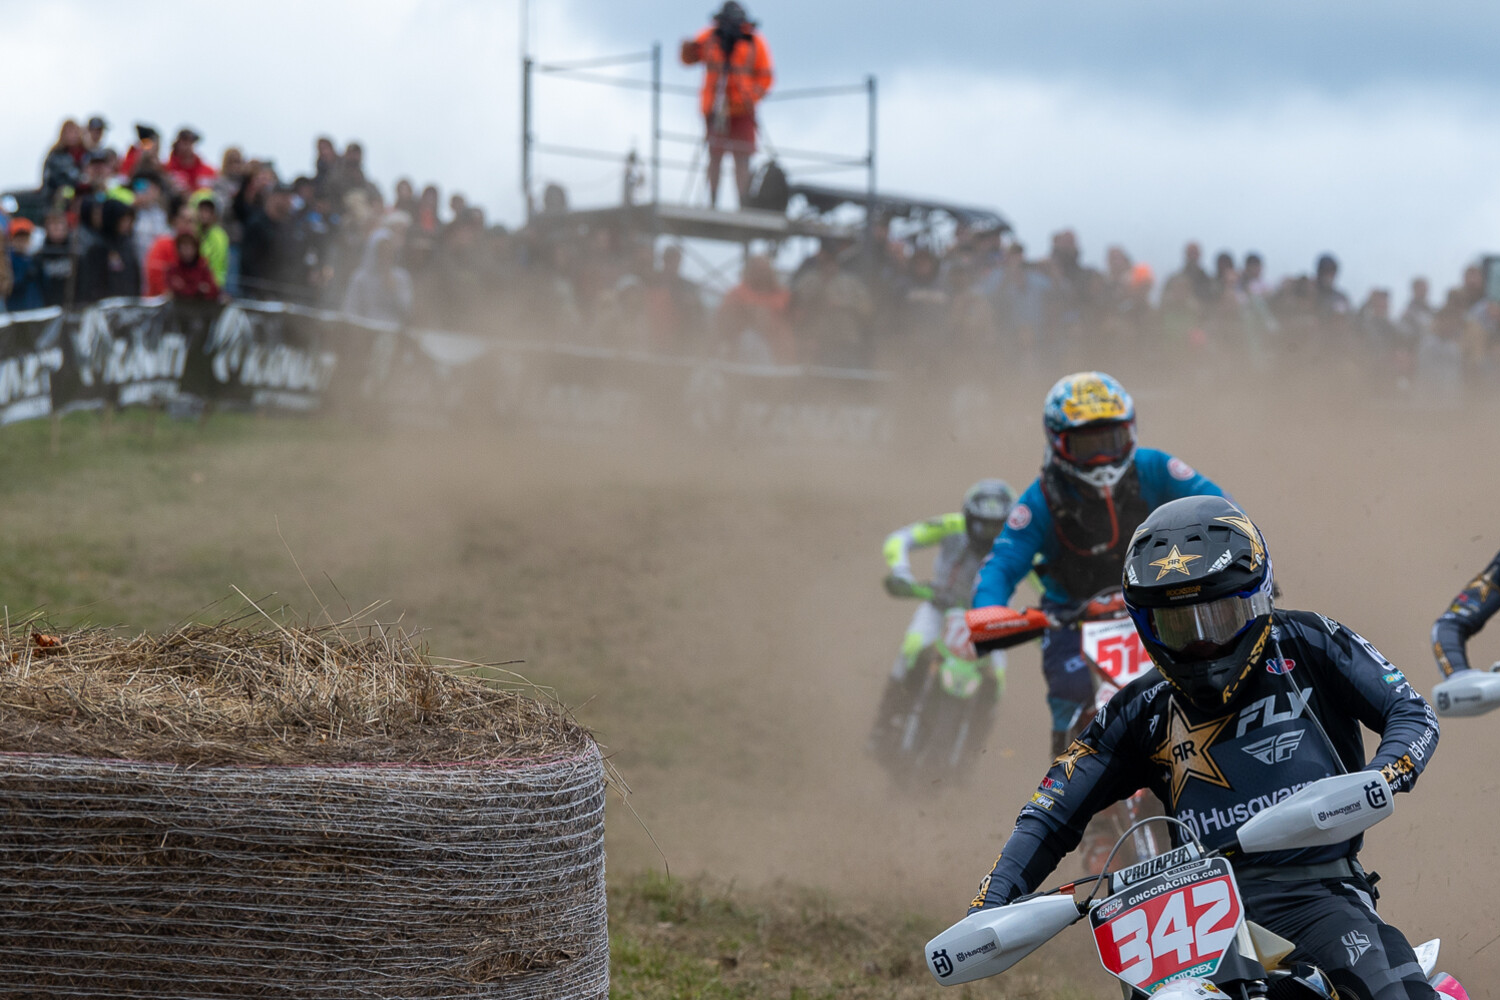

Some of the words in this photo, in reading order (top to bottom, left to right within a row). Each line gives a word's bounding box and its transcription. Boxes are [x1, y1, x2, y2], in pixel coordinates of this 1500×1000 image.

[1166, 586, 1201, 596] ROCKSTAR
[1236, 687, 1313, 738] FLY
[1326, 801, 1361, 818] Husqvarna
[1124, 847, 1188, 883] PROTAPER
[1111, 879, 1234, 986] 342
[965, 940, 996, 958] Husqvarna
[1164, 961, 1214, 984] MOTOREX
